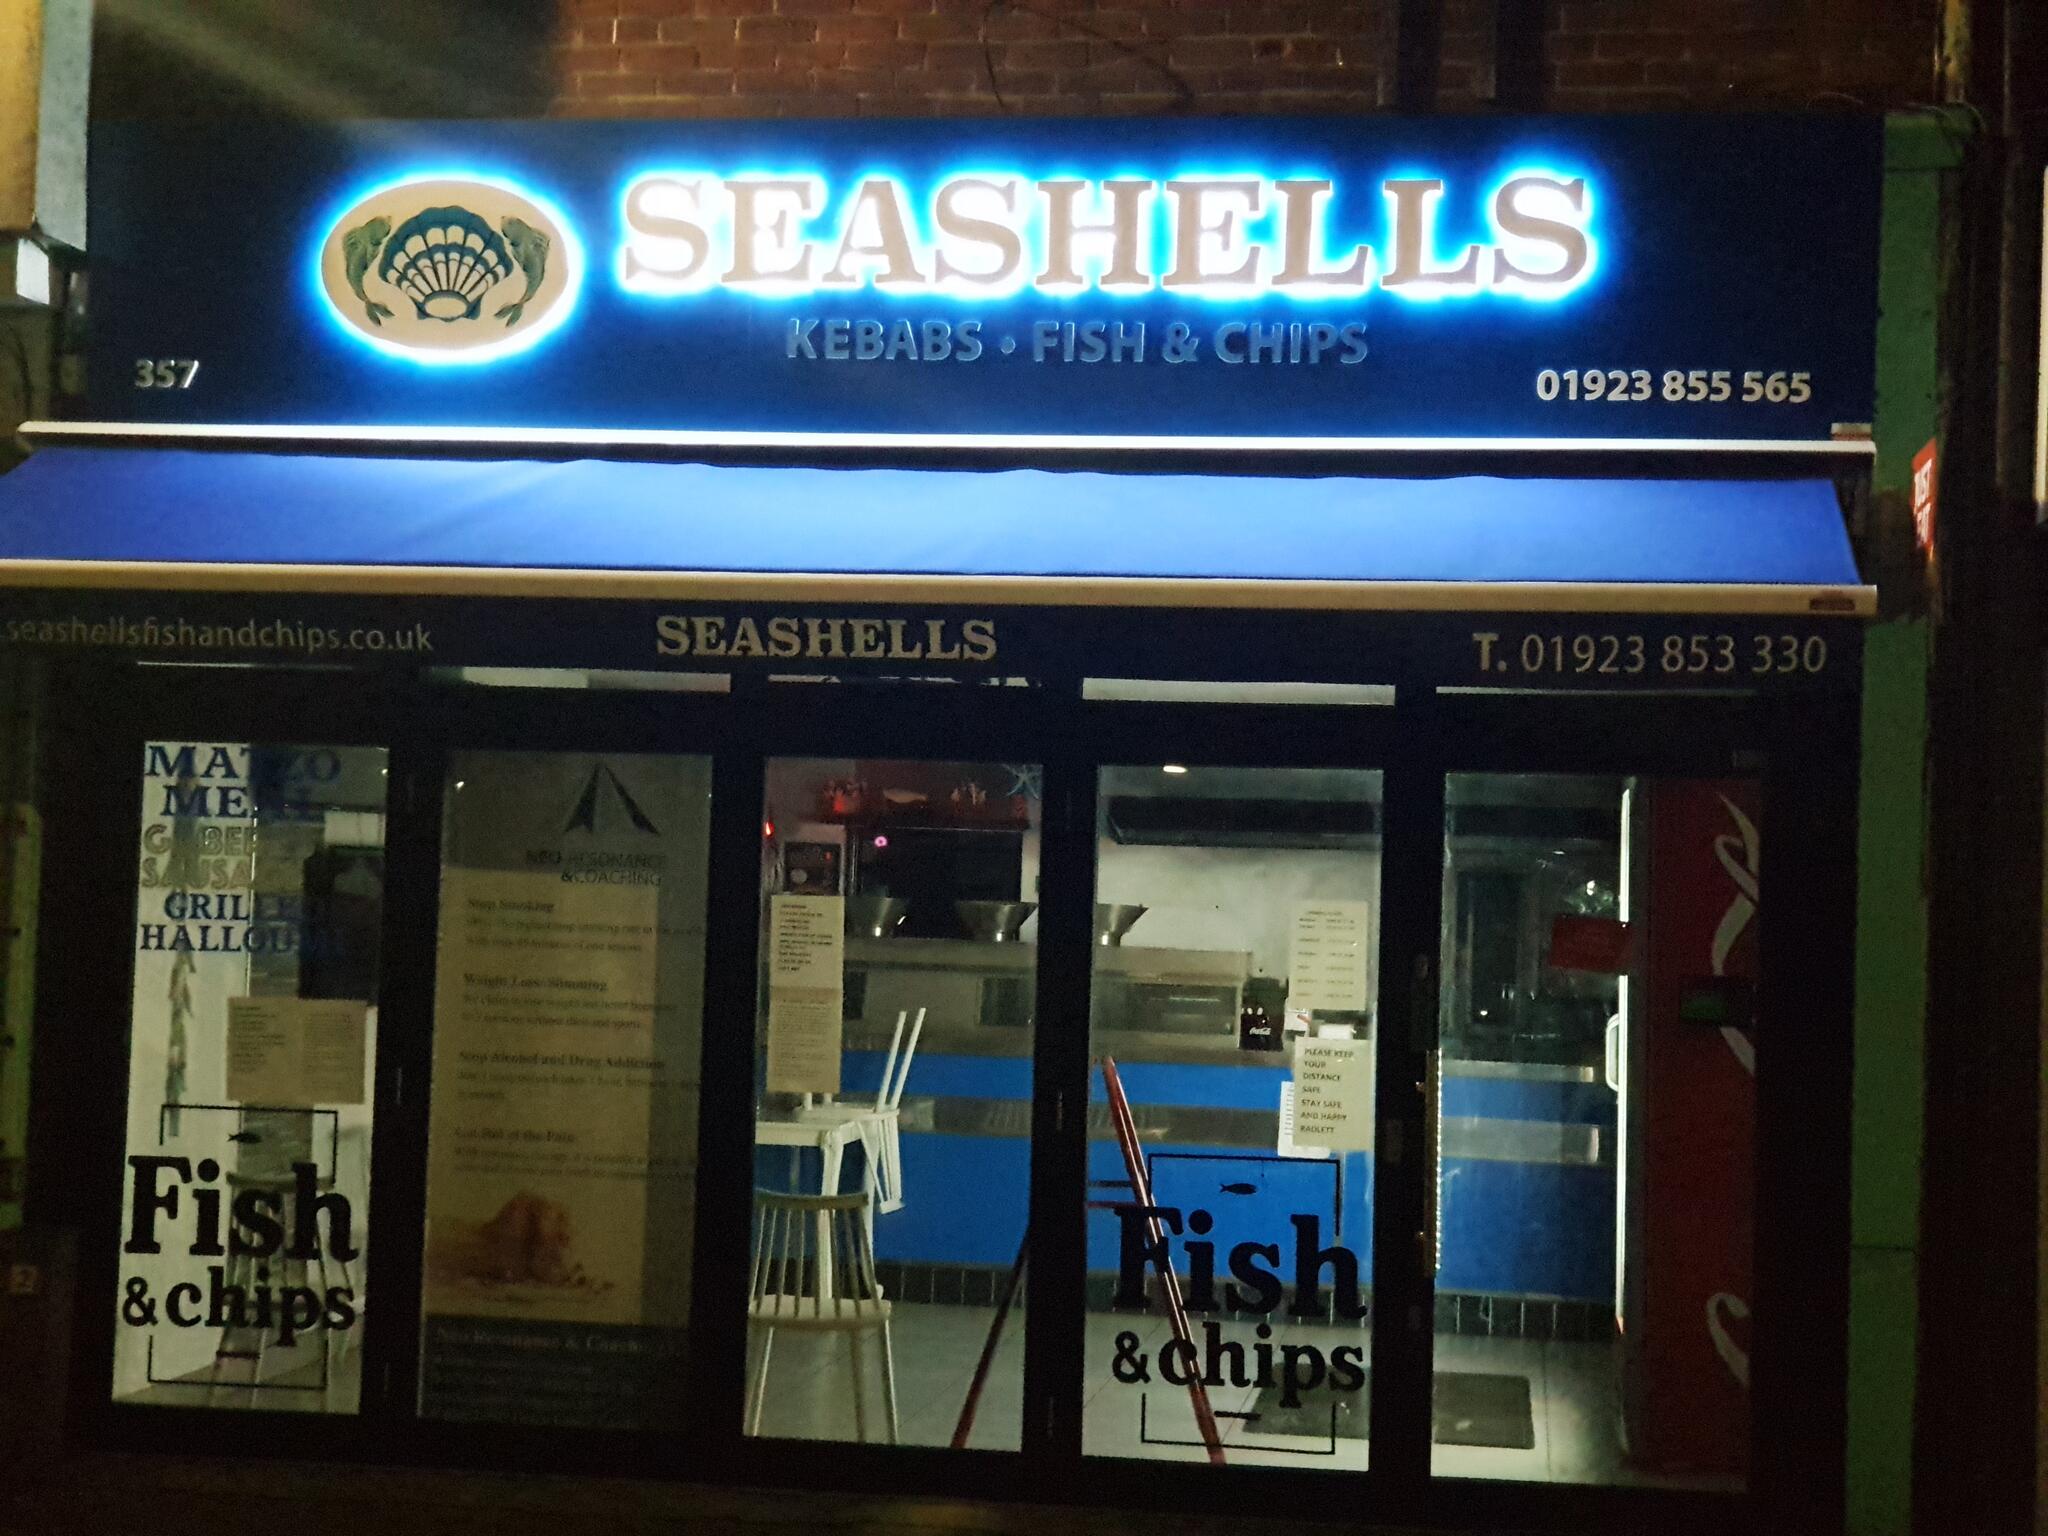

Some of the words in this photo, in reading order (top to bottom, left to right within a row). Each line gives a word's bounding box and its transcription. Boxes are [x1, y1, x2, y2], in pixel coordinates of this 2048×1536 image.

[624, 177, 1586, 288] SEASHELLS
[786, 318, 983, 361] KEBABS
[1032, 321, 1146, 364] FISH
[1161, 323, 1199, 364] &
[1214, 322, 1369, 365] CHIPS
[135, 360, 200, 388] 357
[1537, 369, 1652, 401] 01923
[1662, 370, 1732, 402] 855
[1742, 371, 1812, 403] 565
[656, 615, 997, 661] SEASHELLS
[1472, 632, 1508, 672] T.
[1520, 633, 1647, 673] 01923
[1660, 635, 1736, 673] 853
[1751, 636, 1827, 674] 330
[1302, 1072, 1341, 1081] DISTANCE
[124, 1155, 359, 1262] Fish
[1113, 1206, 1367, 1319] Fish
